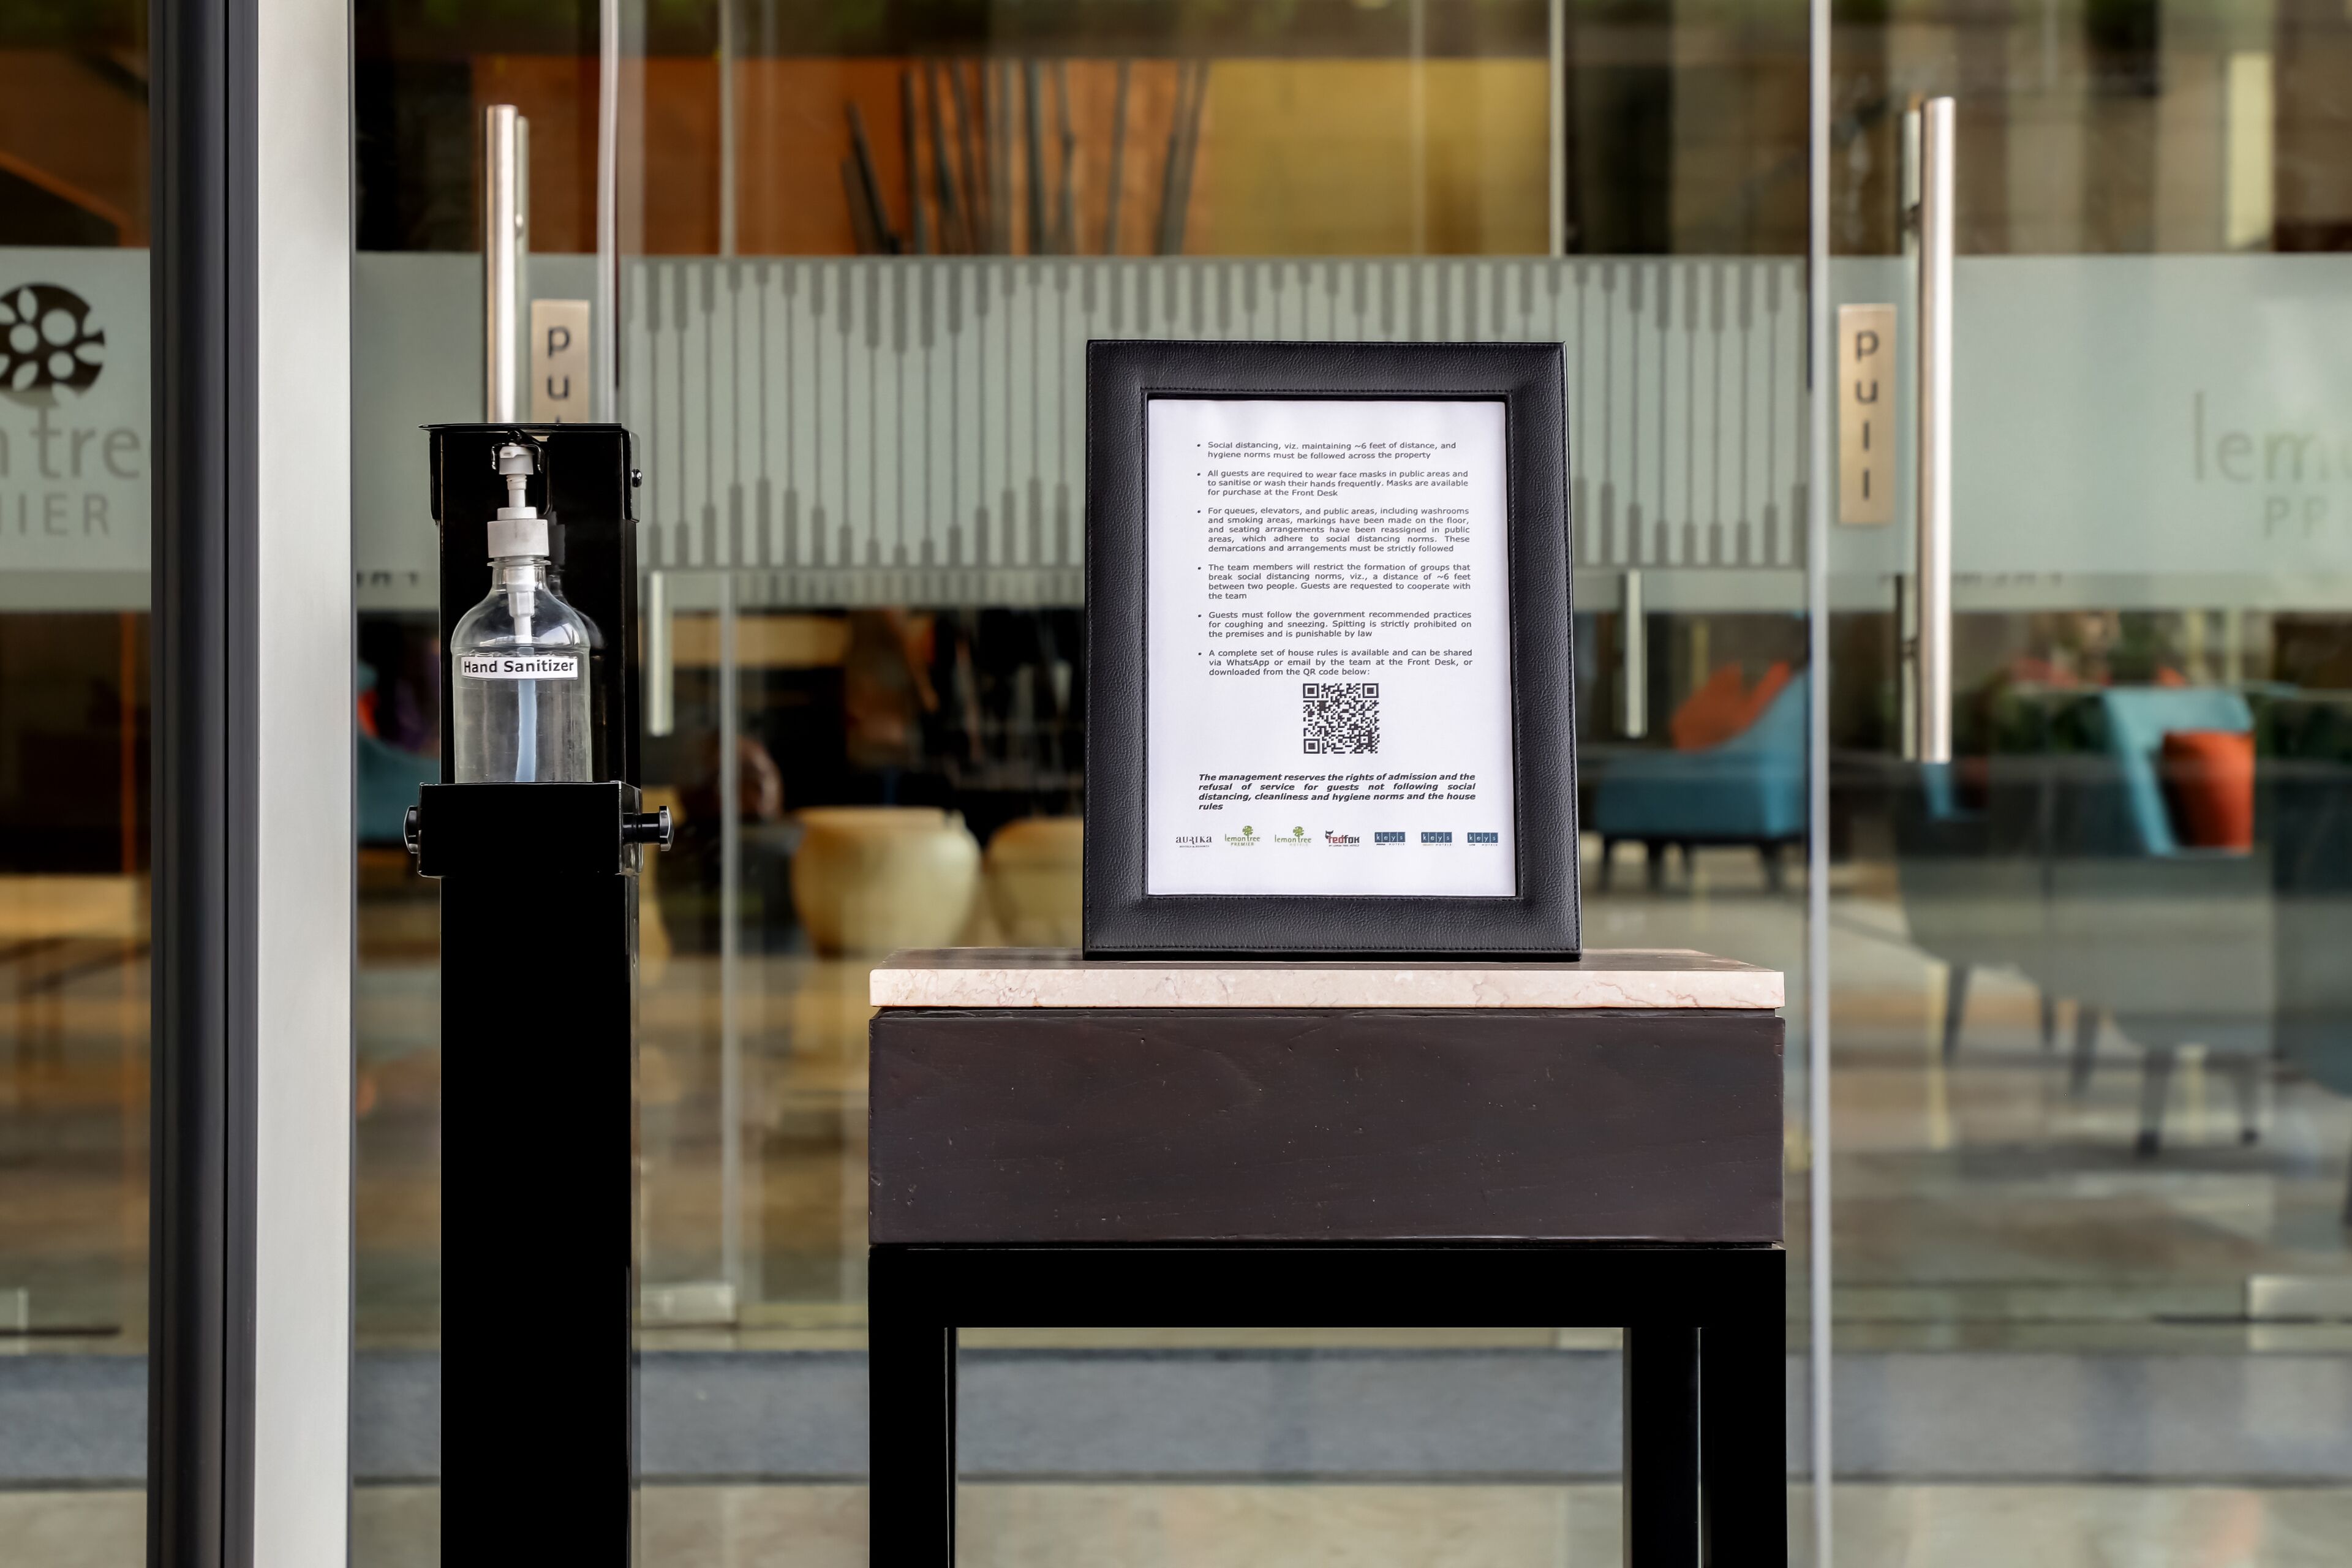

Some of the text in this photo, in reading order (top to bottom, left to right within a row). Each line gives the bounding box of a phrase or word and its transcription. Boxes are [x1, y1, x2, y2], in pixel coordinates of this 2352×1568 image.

[547, 326, 570, 423] pu
[1855, 330, 1880, 501] pull
[30, 409, 151, 481] tre
[1235, 442, 1281, 450] distancing,
[1302, 442, 1352, 451] maintaining
[1399, 442, 1438, 450] distance,
[1207, 450, 1242, 459] hygiene
[1394, 451, 1431, 460] property
[1220, 470, 1249, 478] guests
[1267, 470, 1303, 479] required
[1399, 470, 1425, 478] public
[1223, 488, 1262, 497] purchase
[0, 492, 110, 536] IER
[1260, 507, 1302, 516] elevators,
[1323, 507, 1349, 516] public
[1380, 507, 1419, 516] including
[1313, 611, 1366, 620] government
[1433, 611, 1472, 620] practices
[1224, 620, 1264, 630] coughing
[1287, 620, 1328, 629] sneezing.
[1332, 620, 1366, 629] Spitting
[1380, 620, 1410, 629] strictly
[1414, 620, 1457, 629] prohibited
[1225, 630, 1265, 639] premises
[1295, 629, 1342, 639] punishable
[1344, 629, 1355, 638] by
[1218, 649, 1258, 658] complete
[464, 659, 574, 673] Hand Sanitizer
[1226, 658, 1270, 668] WhatsApp
[1315, 658, 1327, 668] by
[1434, 658, 1459, 667] Desk,
[1208, 668, 1261, 676] downloaded
[1303, 668, 1316, 677] QR
[1199, 773, 1217, 782] The
[1218, 774, 1283, 783] management
[1327, 773, 1344, 782] the
[1345, 773, 1375, 783] rights
[1376, 772, 1387, 781] of
[1459, 772, 1476, 781] the
[1241, 782, 1253, 791] of
[1326, 783, 1360, 793] guests
[1393, 782, 1439, 792] following
[1198, 792, 1252, 802] distancing,
[1254, 792, 1310, 801] cleanliness
[1332, 793, 1371, 802] hygiene
[1446, 792, 1476, 801] house
[1275, 834, 1297, 843] lemon
[1376, 833, 1404, 842] keys
[1422, 833, 1450, 842] keys
[1469, 834, 1497, 843] keys
